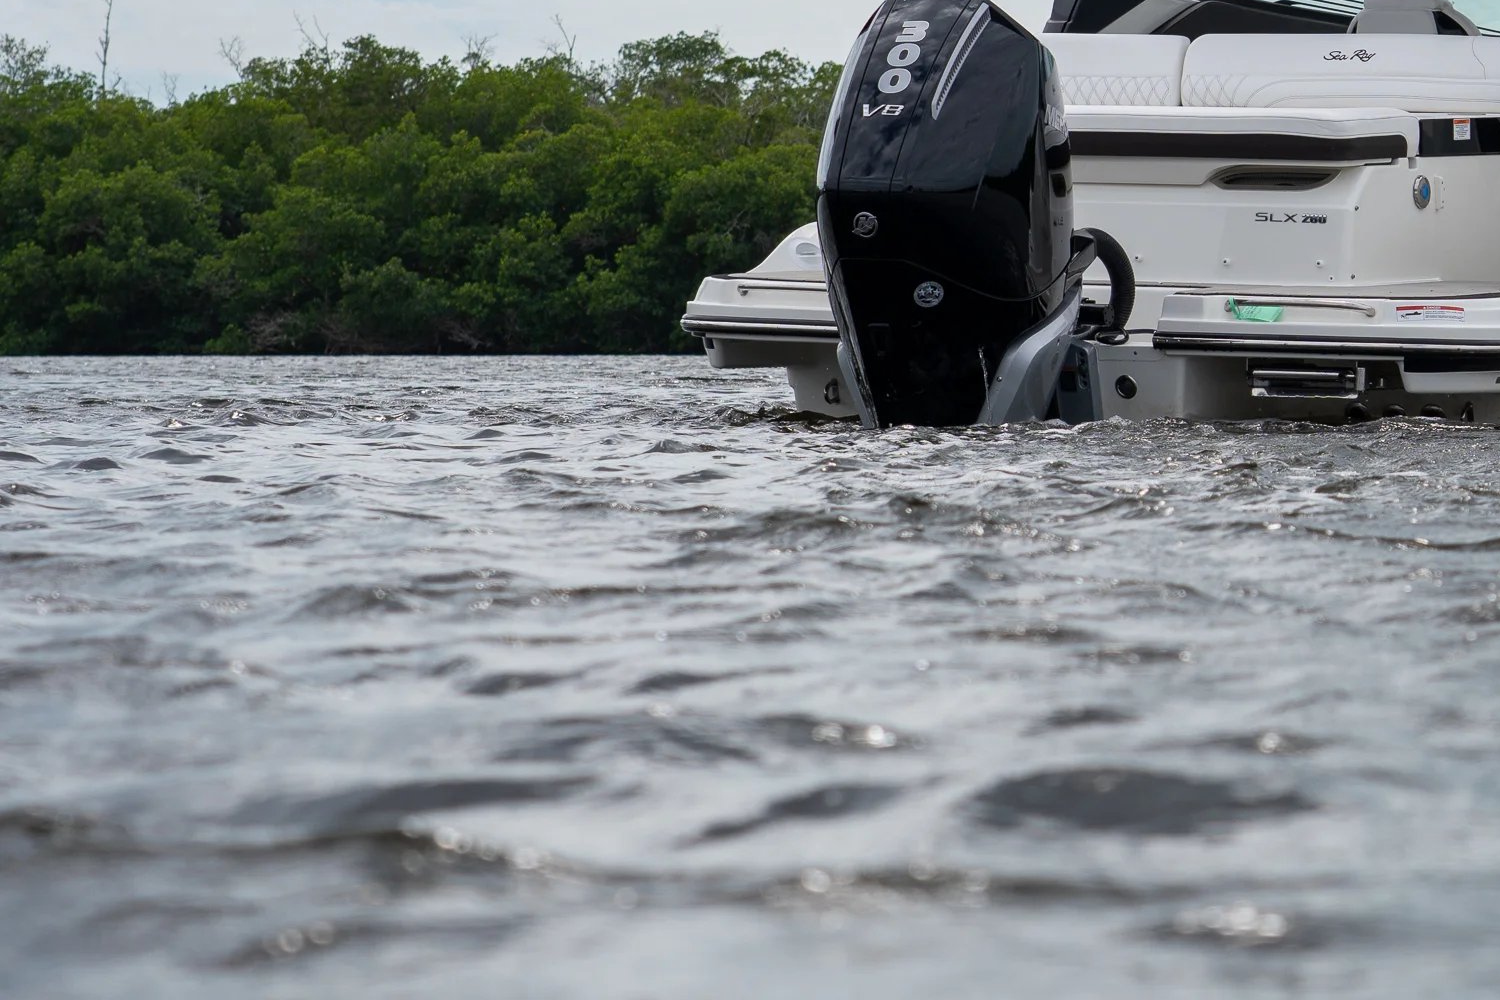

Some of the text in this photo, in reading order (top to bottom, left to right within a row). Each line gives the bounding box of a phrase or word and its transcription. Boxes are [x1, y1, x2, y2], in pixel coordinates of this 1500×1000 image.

[877, 20, 930, 94] 300
[1323, 49, 1376, 62] Sea Ray
[862, 103, 905, 117] V8
[1255, 212, 1298, 223] SLX
